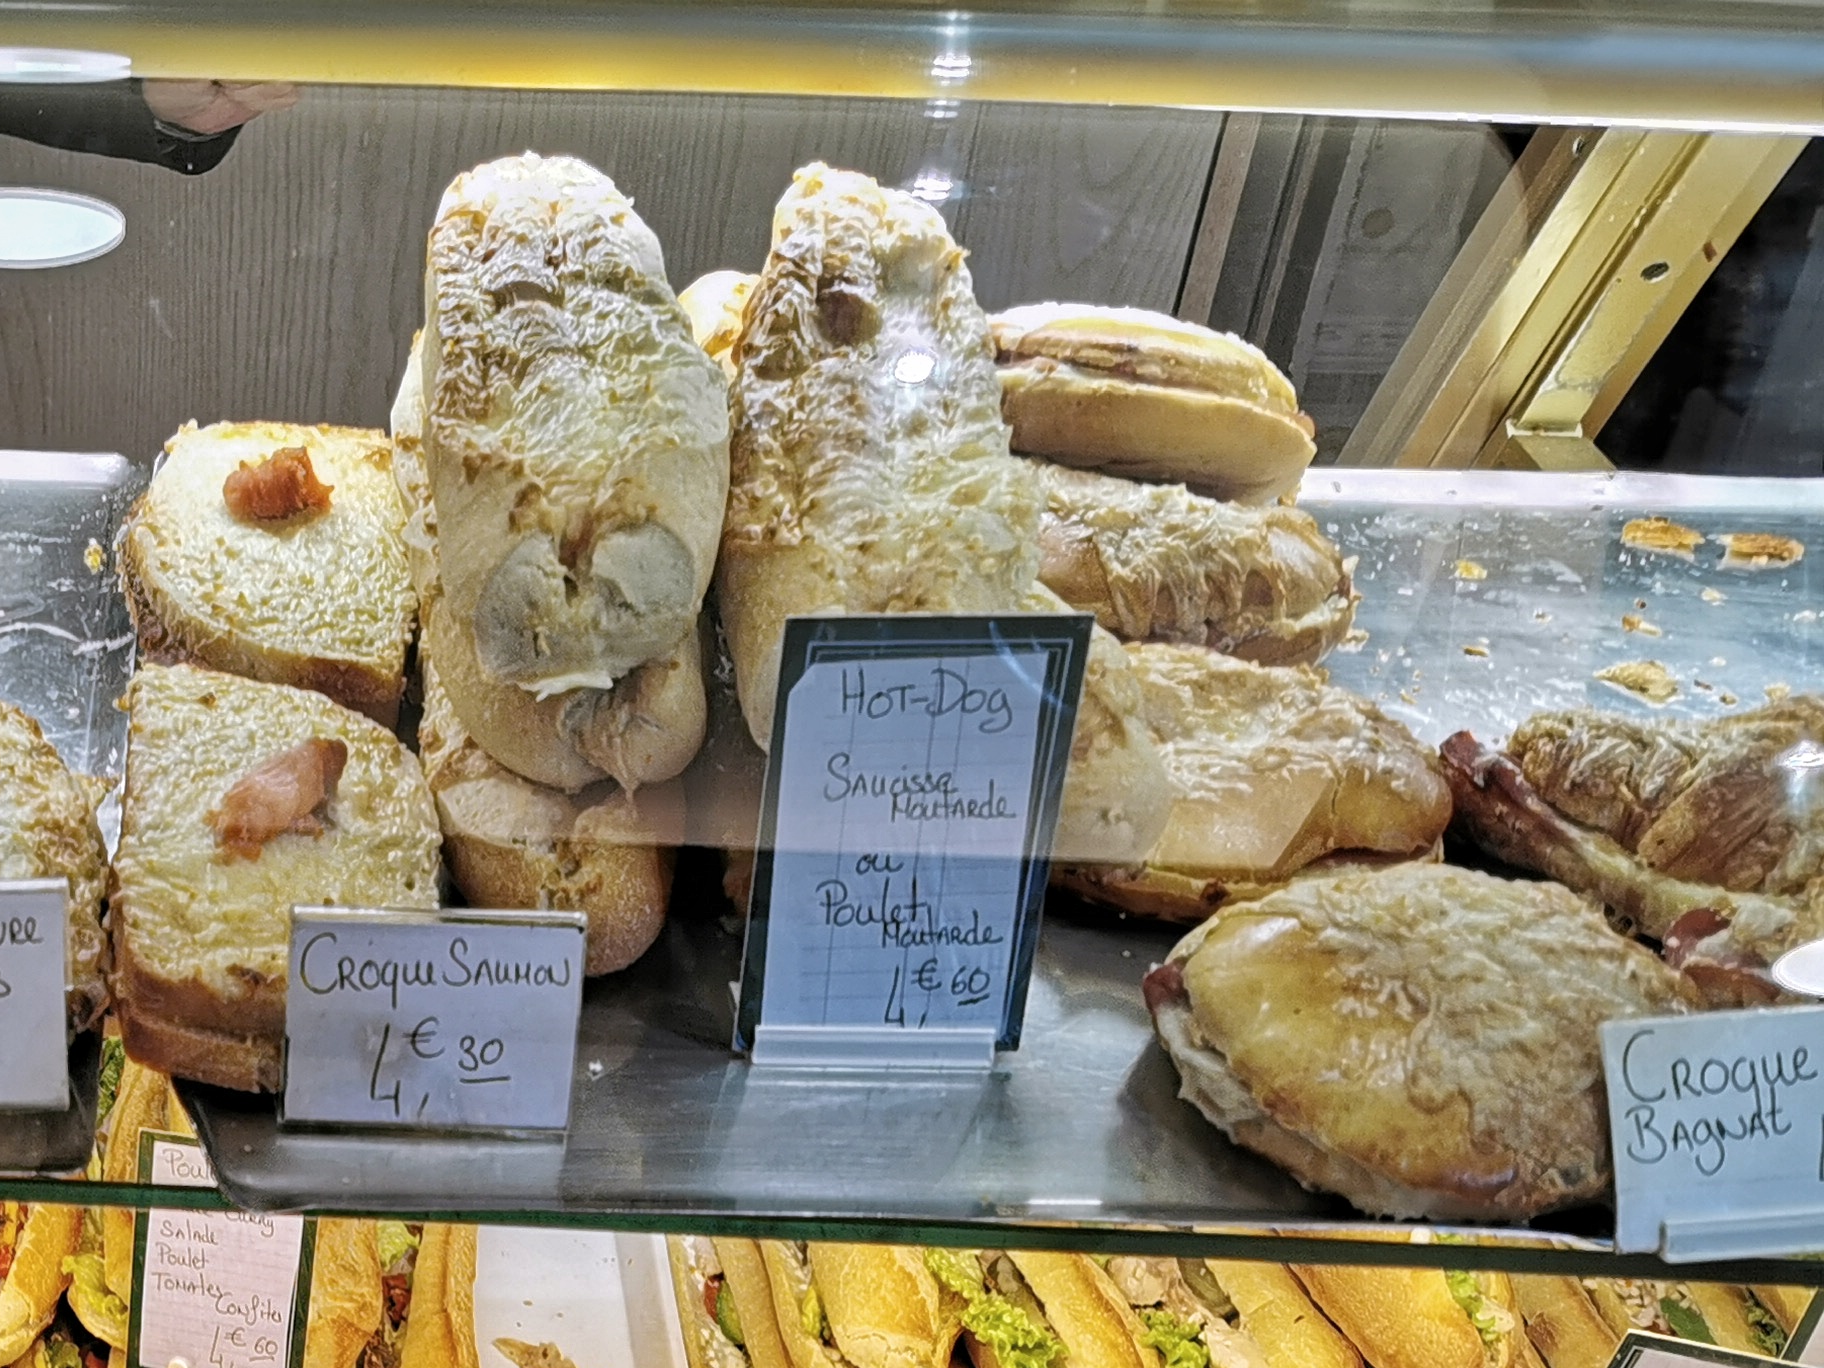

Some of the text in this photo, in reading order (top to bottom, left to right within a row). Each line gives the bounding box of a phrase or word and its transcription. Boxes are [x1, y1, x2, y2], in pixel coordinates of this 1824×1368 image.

[855, 853, 905, 875] ou
[816, 876, 927, 927] Poulet
[1623, 1030, 1818, 1112] Croque
[1625, 1104, 1791, 1176] Bagnat
[162, 1148, 216, 1181] Poul
[159, 1219, 218, 1246] Salade
[155, 1242, 209, 1270] Poulet
